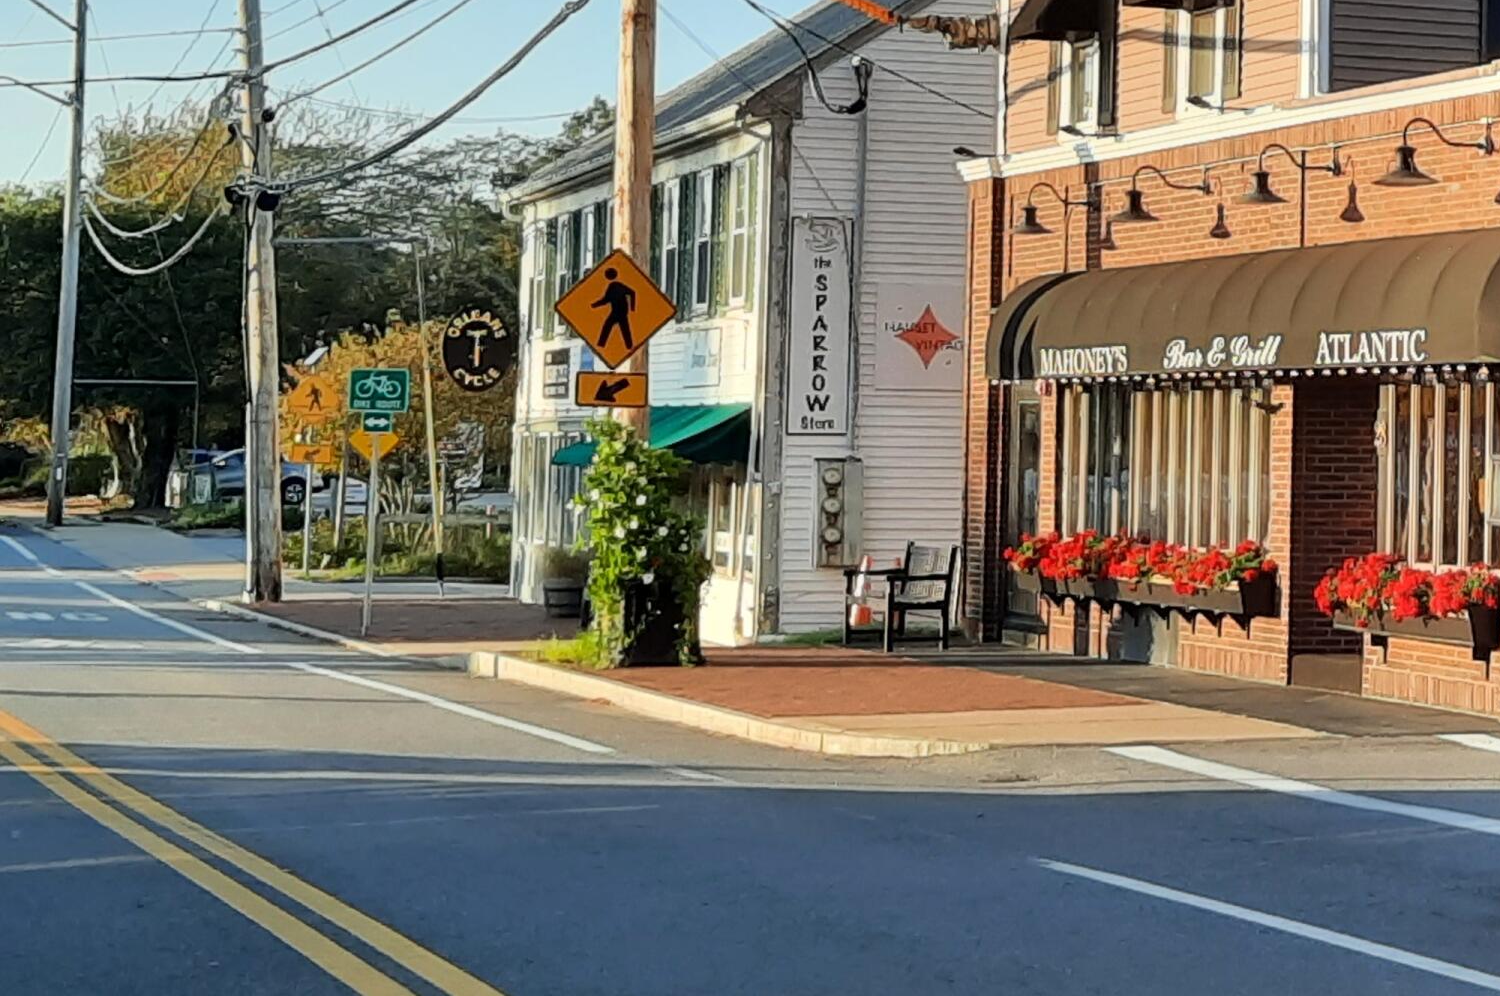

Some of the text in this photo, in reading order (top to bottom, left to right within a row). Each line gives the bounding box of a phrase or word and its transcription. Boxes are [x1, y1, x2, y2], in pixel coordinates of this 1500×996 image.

[814, 257, 832, 269] the
[805, 274, 831, 413] SPARROW
[915, 339, 964, 351] VINTAG
[1040, 329, 1427, 375] MAHONEY'S Bar & Grill ATLANTIC
[453, 367, 500, 386] CYCLE
